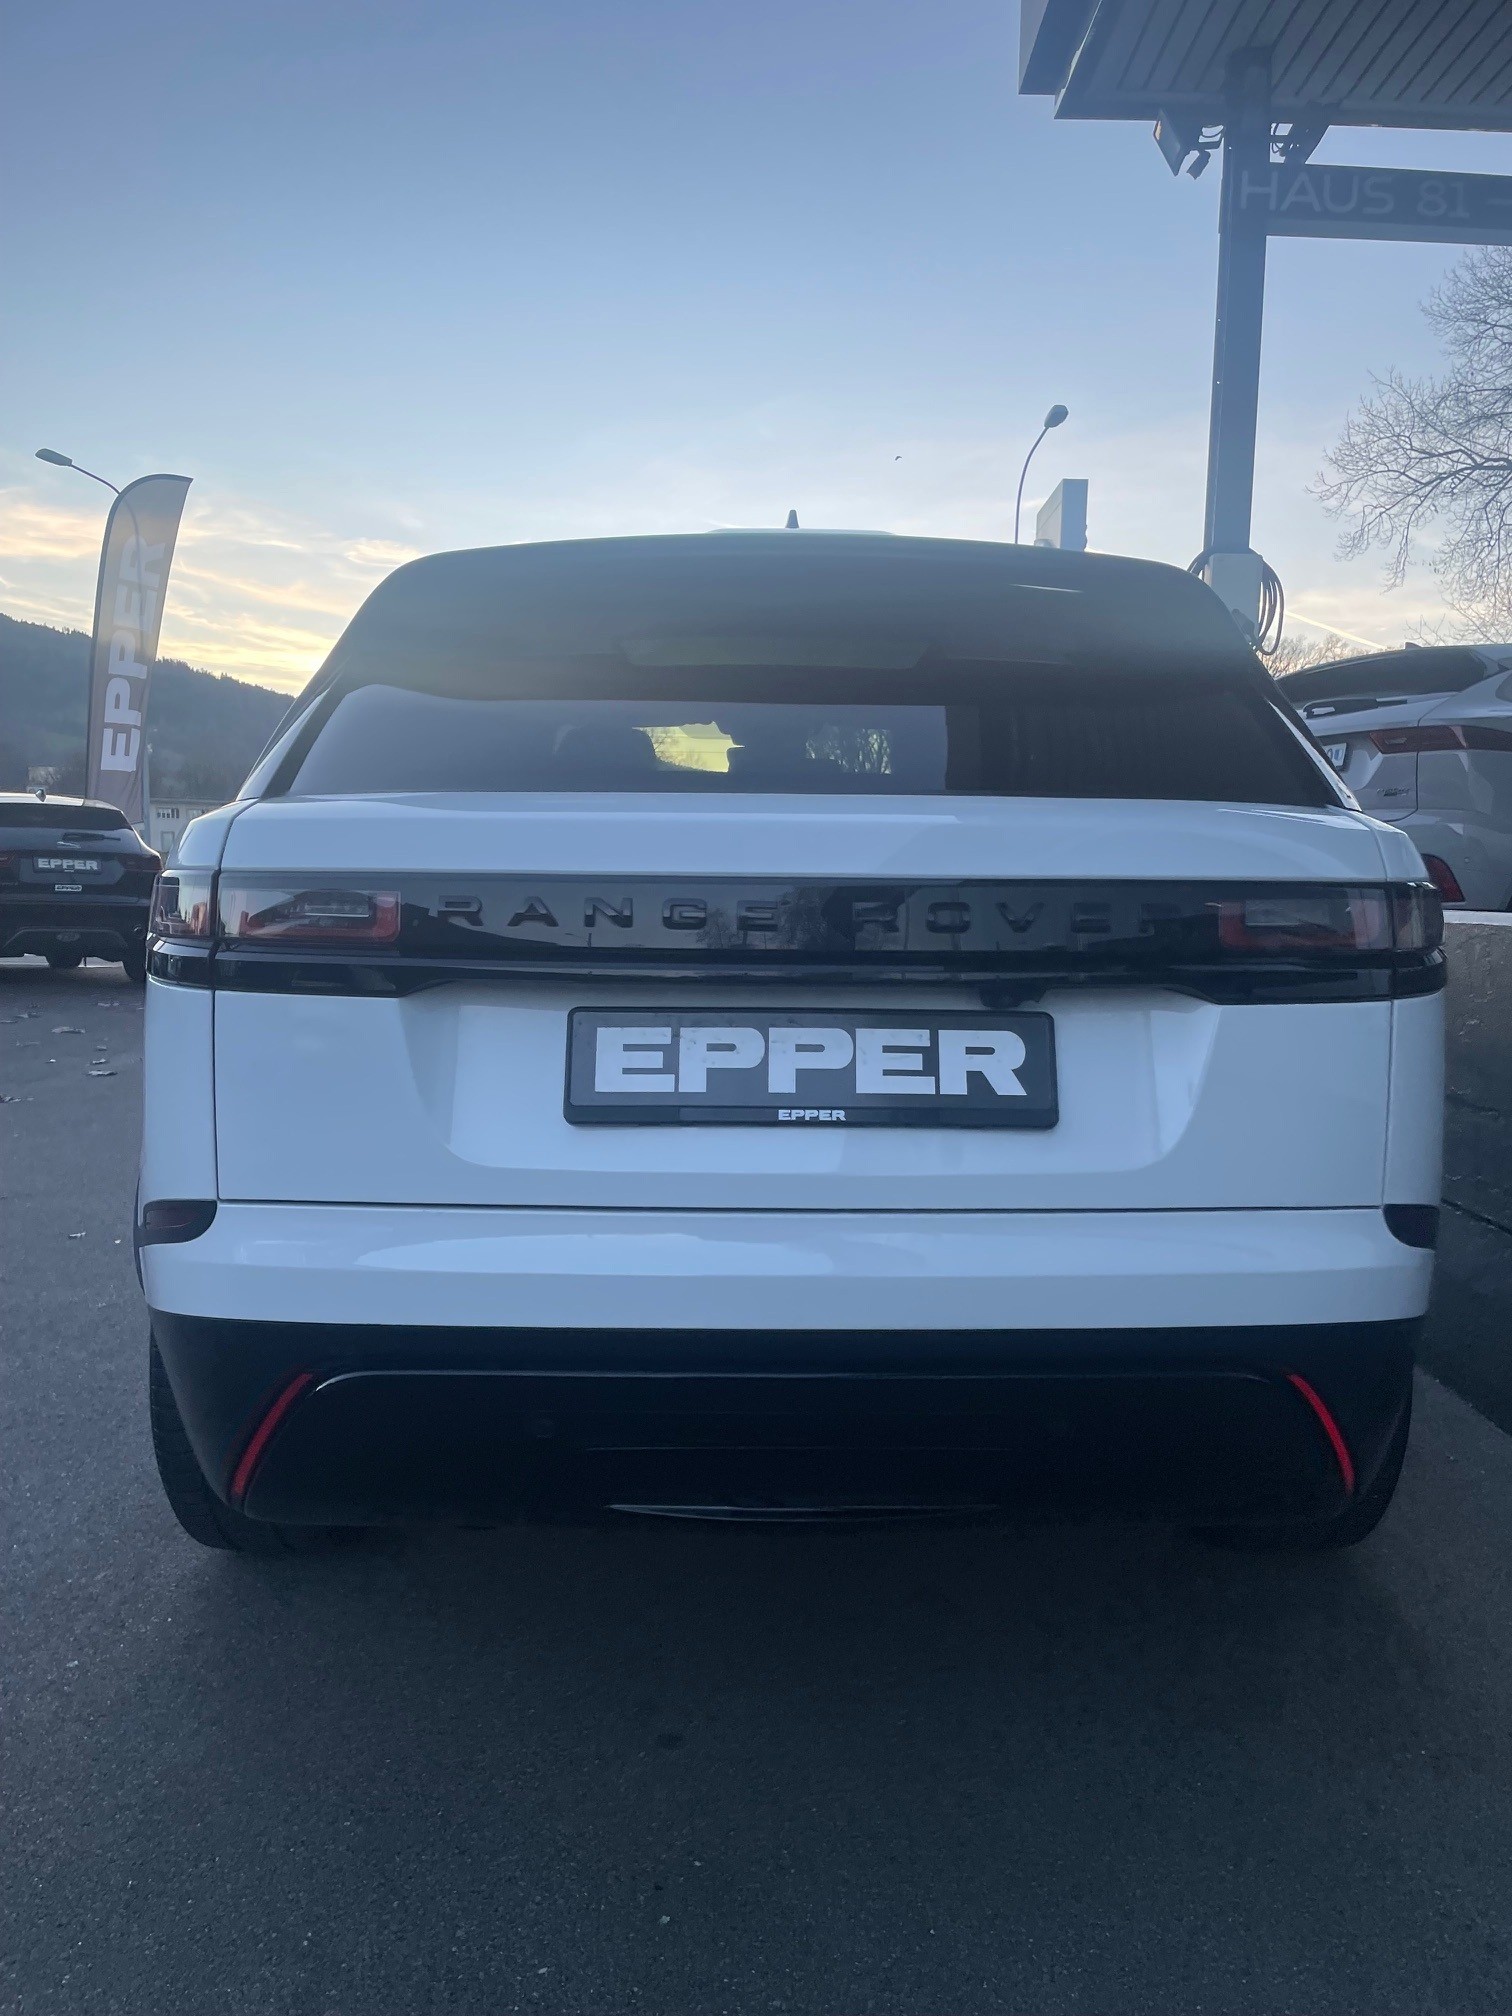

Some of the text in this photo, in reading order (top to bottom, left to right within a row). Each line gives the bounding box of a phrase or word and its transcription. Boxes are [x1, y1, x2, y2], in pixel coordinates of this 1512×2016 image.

[1240, 169, 1395, 215] HAUS
[1416, 179, 1470, 219] 81
[101, 534, 166, 772] EPPER
[38, 858, 98, 870] EPPER
[438, 895, 779, 932] RANGE
[595, 1026, 1028, 1096] EPPER
[778, 1109, 847, 1121] EPPER
